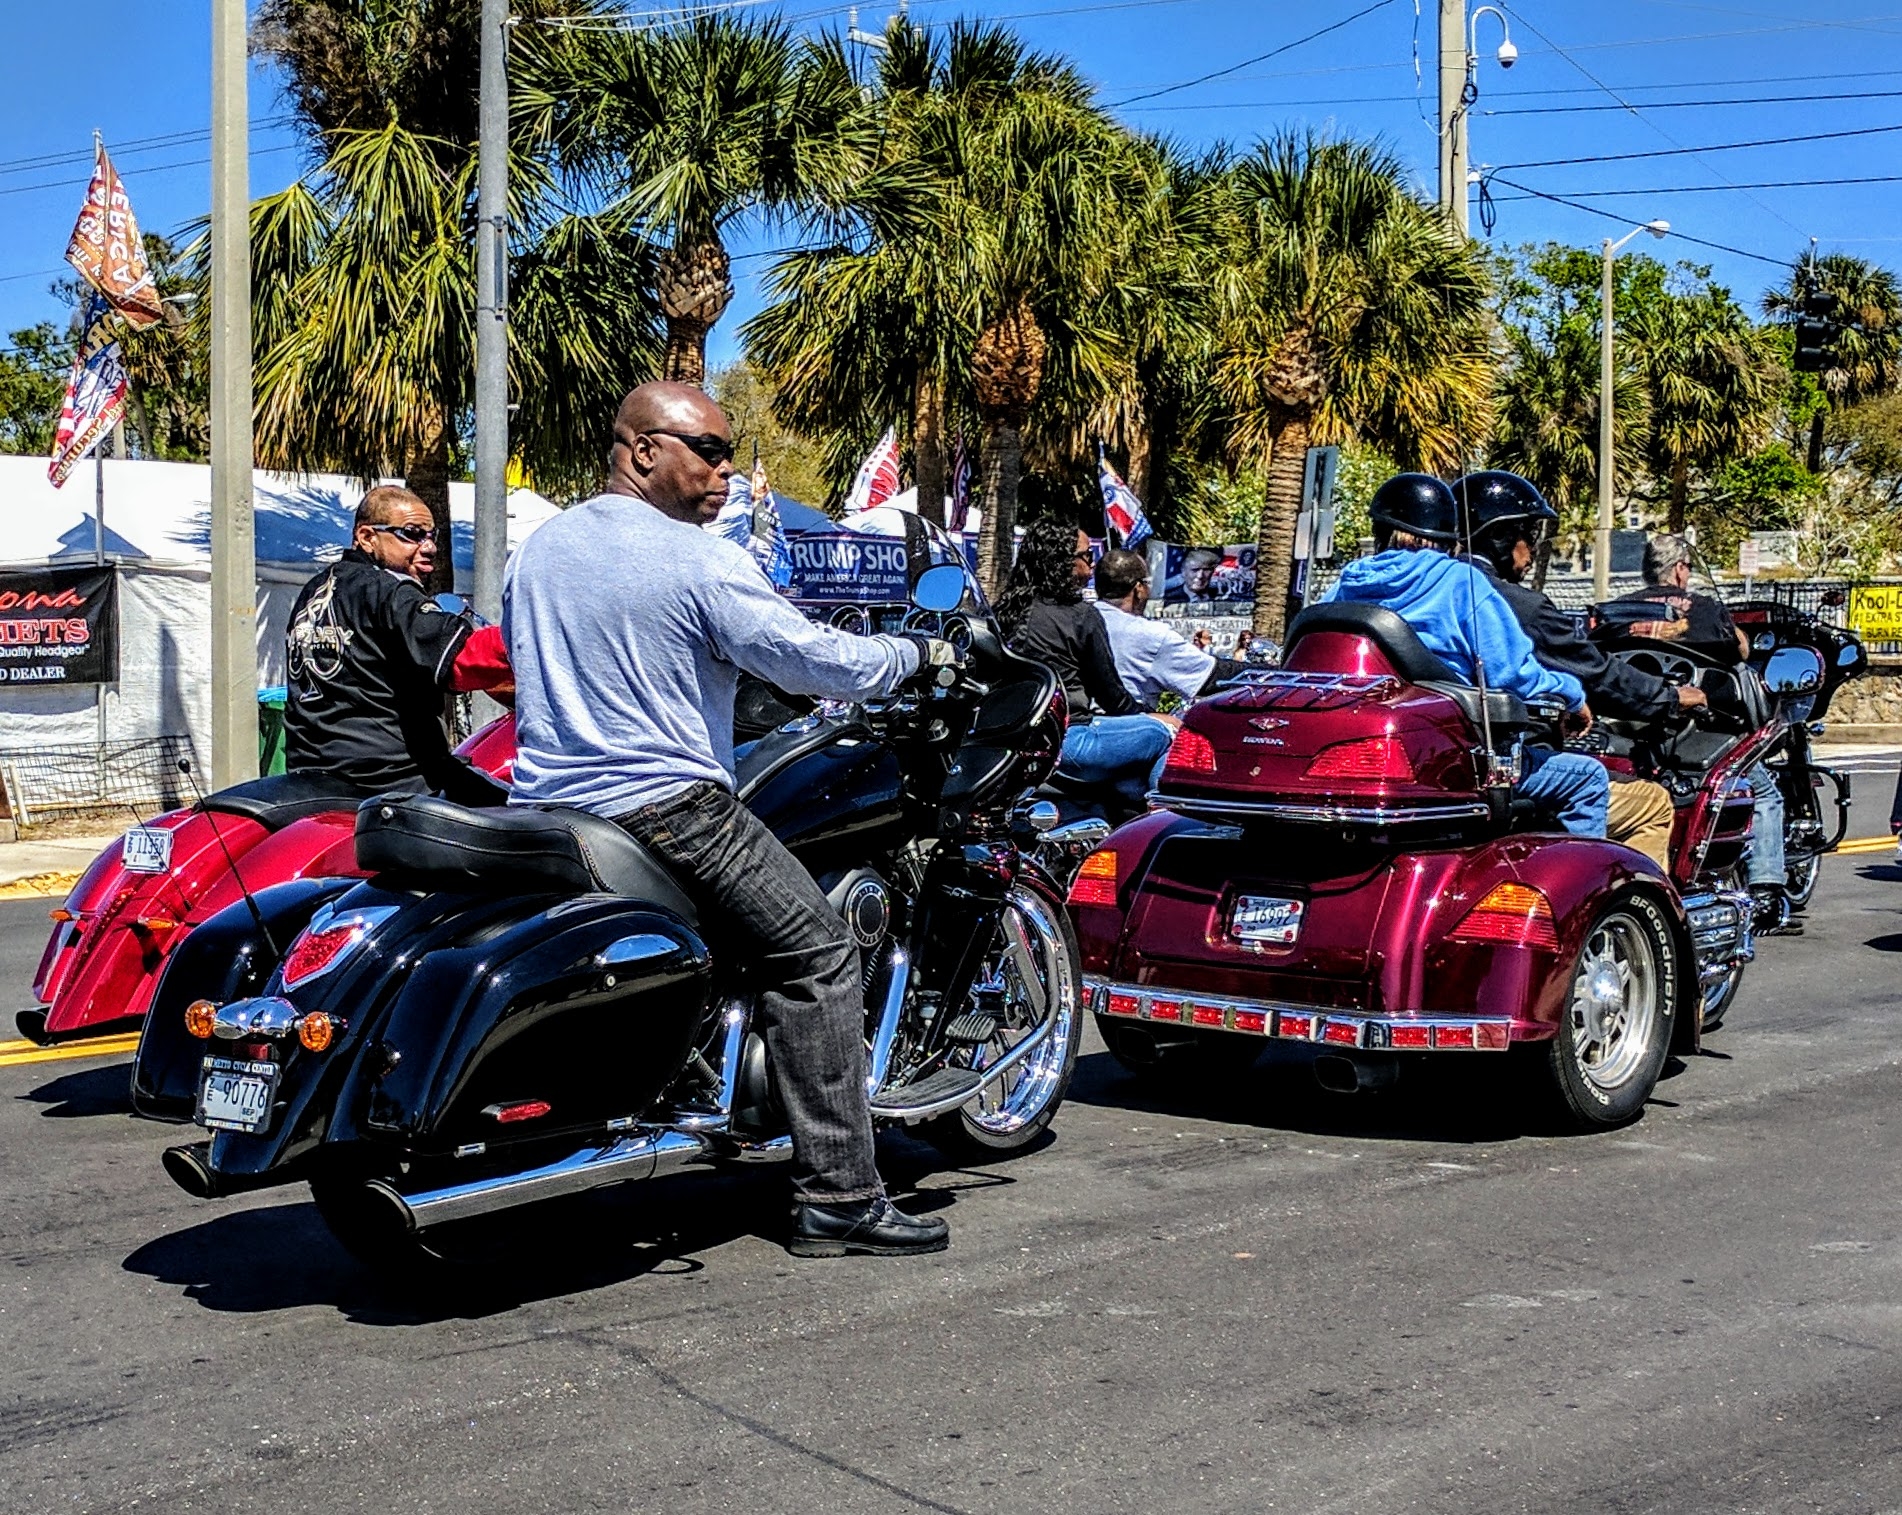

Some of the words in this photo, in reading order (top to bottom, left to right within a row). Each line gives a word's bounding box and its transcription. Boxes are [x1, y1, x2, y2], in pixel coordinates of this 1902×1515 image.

[804, 572, 825, 583] MAKE
[826, 573, 858, 583] AMERICA
[859, 573, 882, 584] GREAT
[1866, 612, 1892, 623] EXTRA
[1867, 627, 1889, 638] BURN
[10, 666, 66, 680] DEALER
[1242, 736, 1284, 747] HONDA
[1251, 906, 1292, 926] 16992
[223, 1080, 266, 1109] 90776
[242, 1107, 255, 1116] SEP
